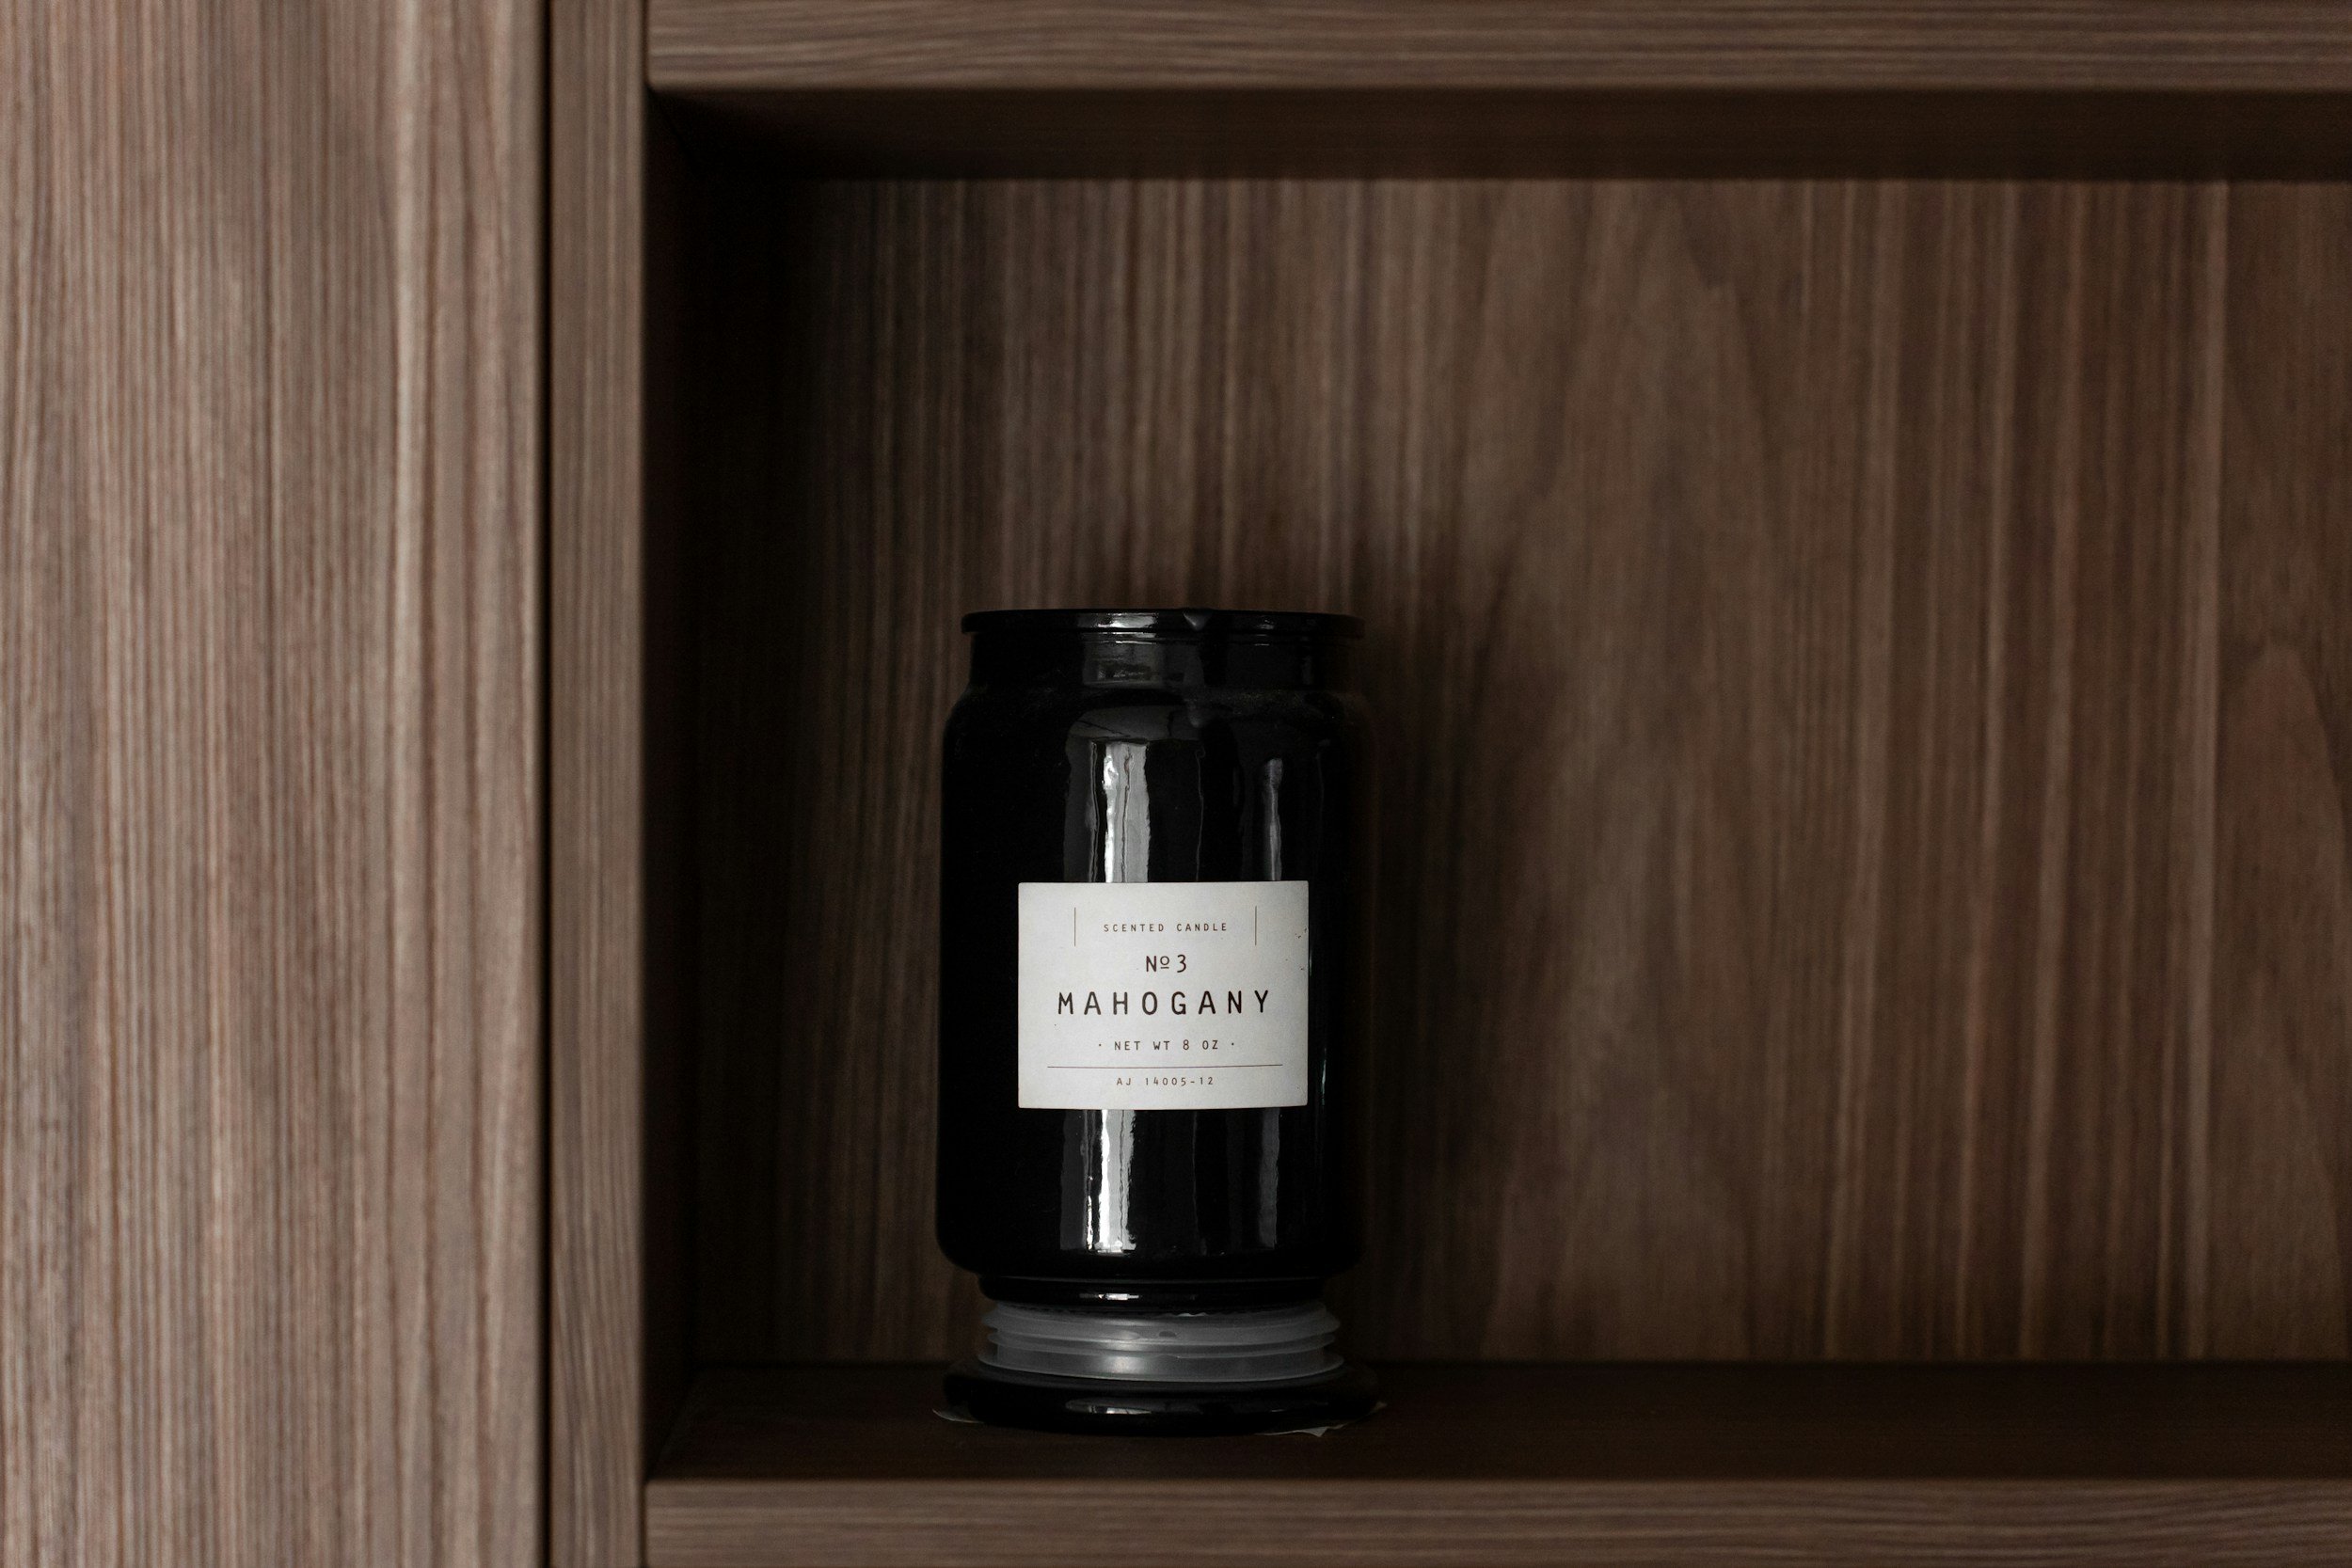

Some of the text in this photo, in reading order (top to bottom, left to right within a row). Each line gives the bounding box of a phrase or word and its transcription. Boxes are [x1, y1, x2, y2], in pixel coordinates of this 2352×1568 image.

[1103, 921, 1228, 932] SCENTED CANDLE
[1057, 989, 1269, 1016] MAHOGANY
[1113, 1038, 1219, 1051] NET WT 8 OZ
[1115, 1075, 1214, 1086] AJ 14005-12
